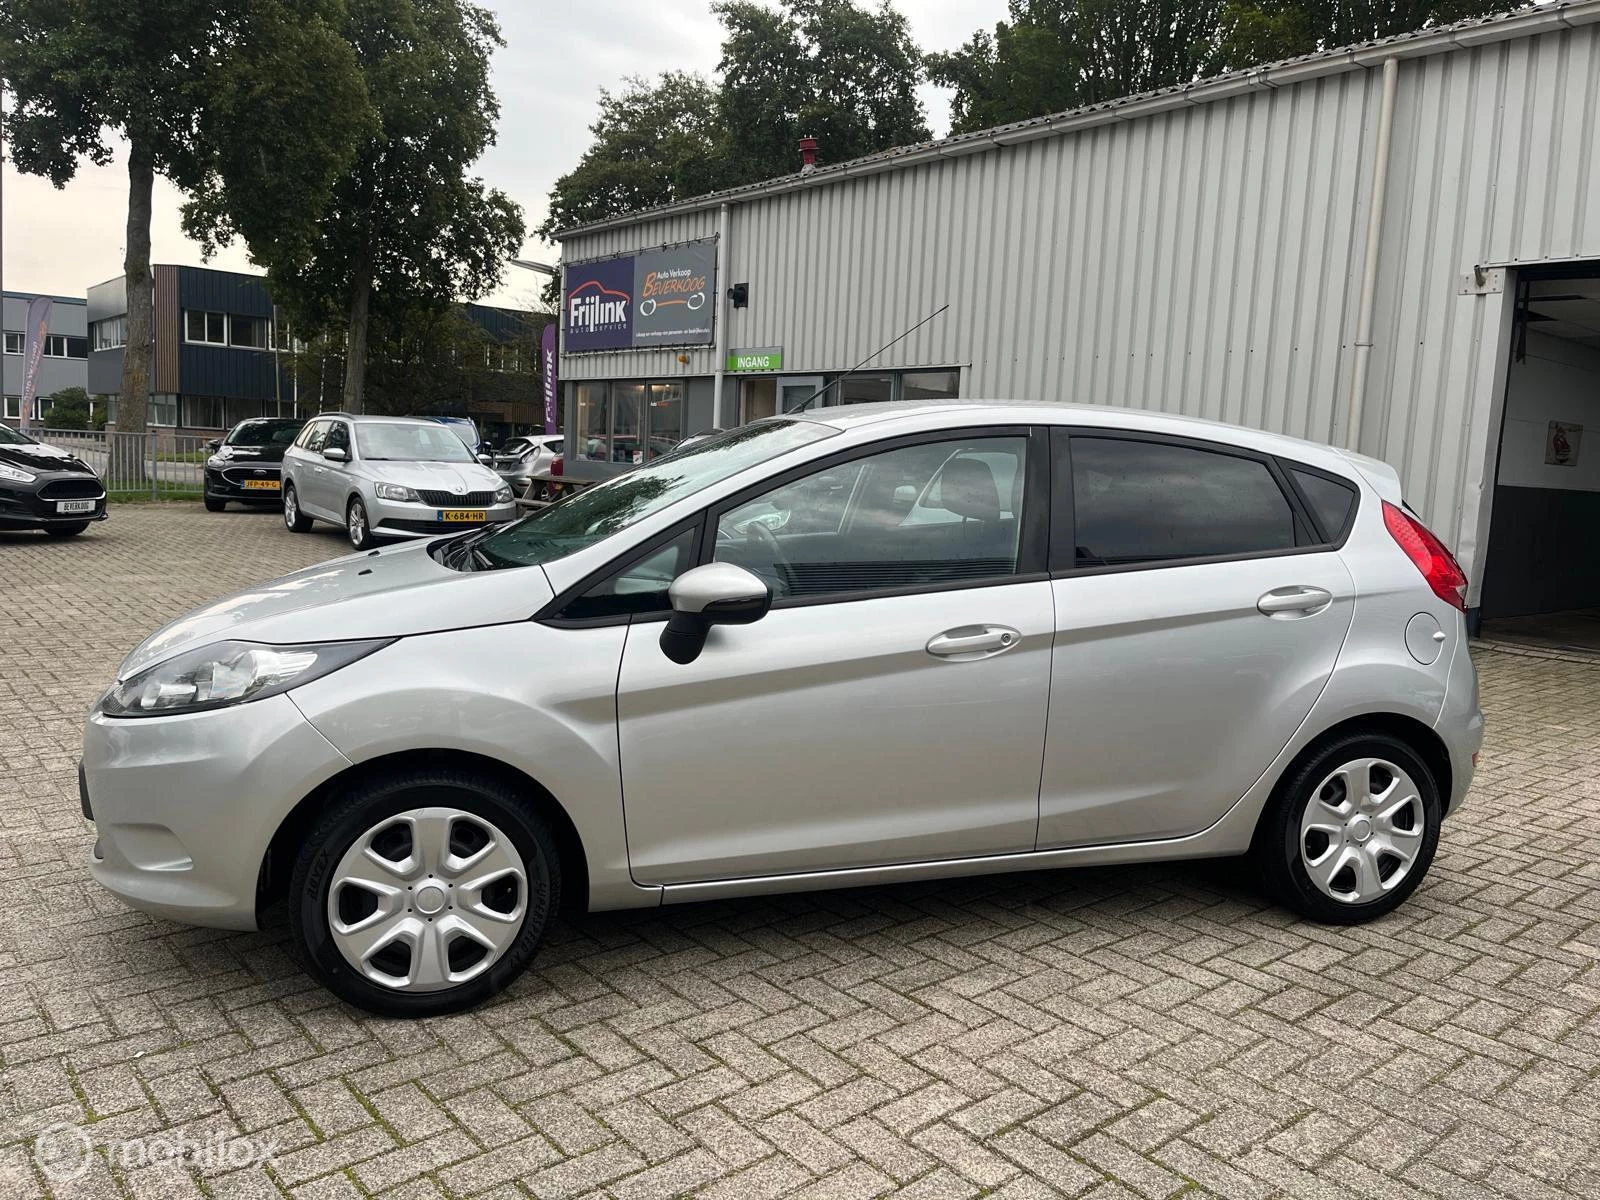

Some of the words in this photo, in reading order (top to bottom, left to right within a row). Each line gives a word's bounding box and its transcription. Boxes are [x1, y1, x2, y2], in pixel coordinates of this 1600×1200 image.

[657, 271, 669, 279] Auto
[669, 268, 691, 278] Verkoop
[737, 355, 769, 368] INGANG
[445, 512, 484, 520] K-684-HR
